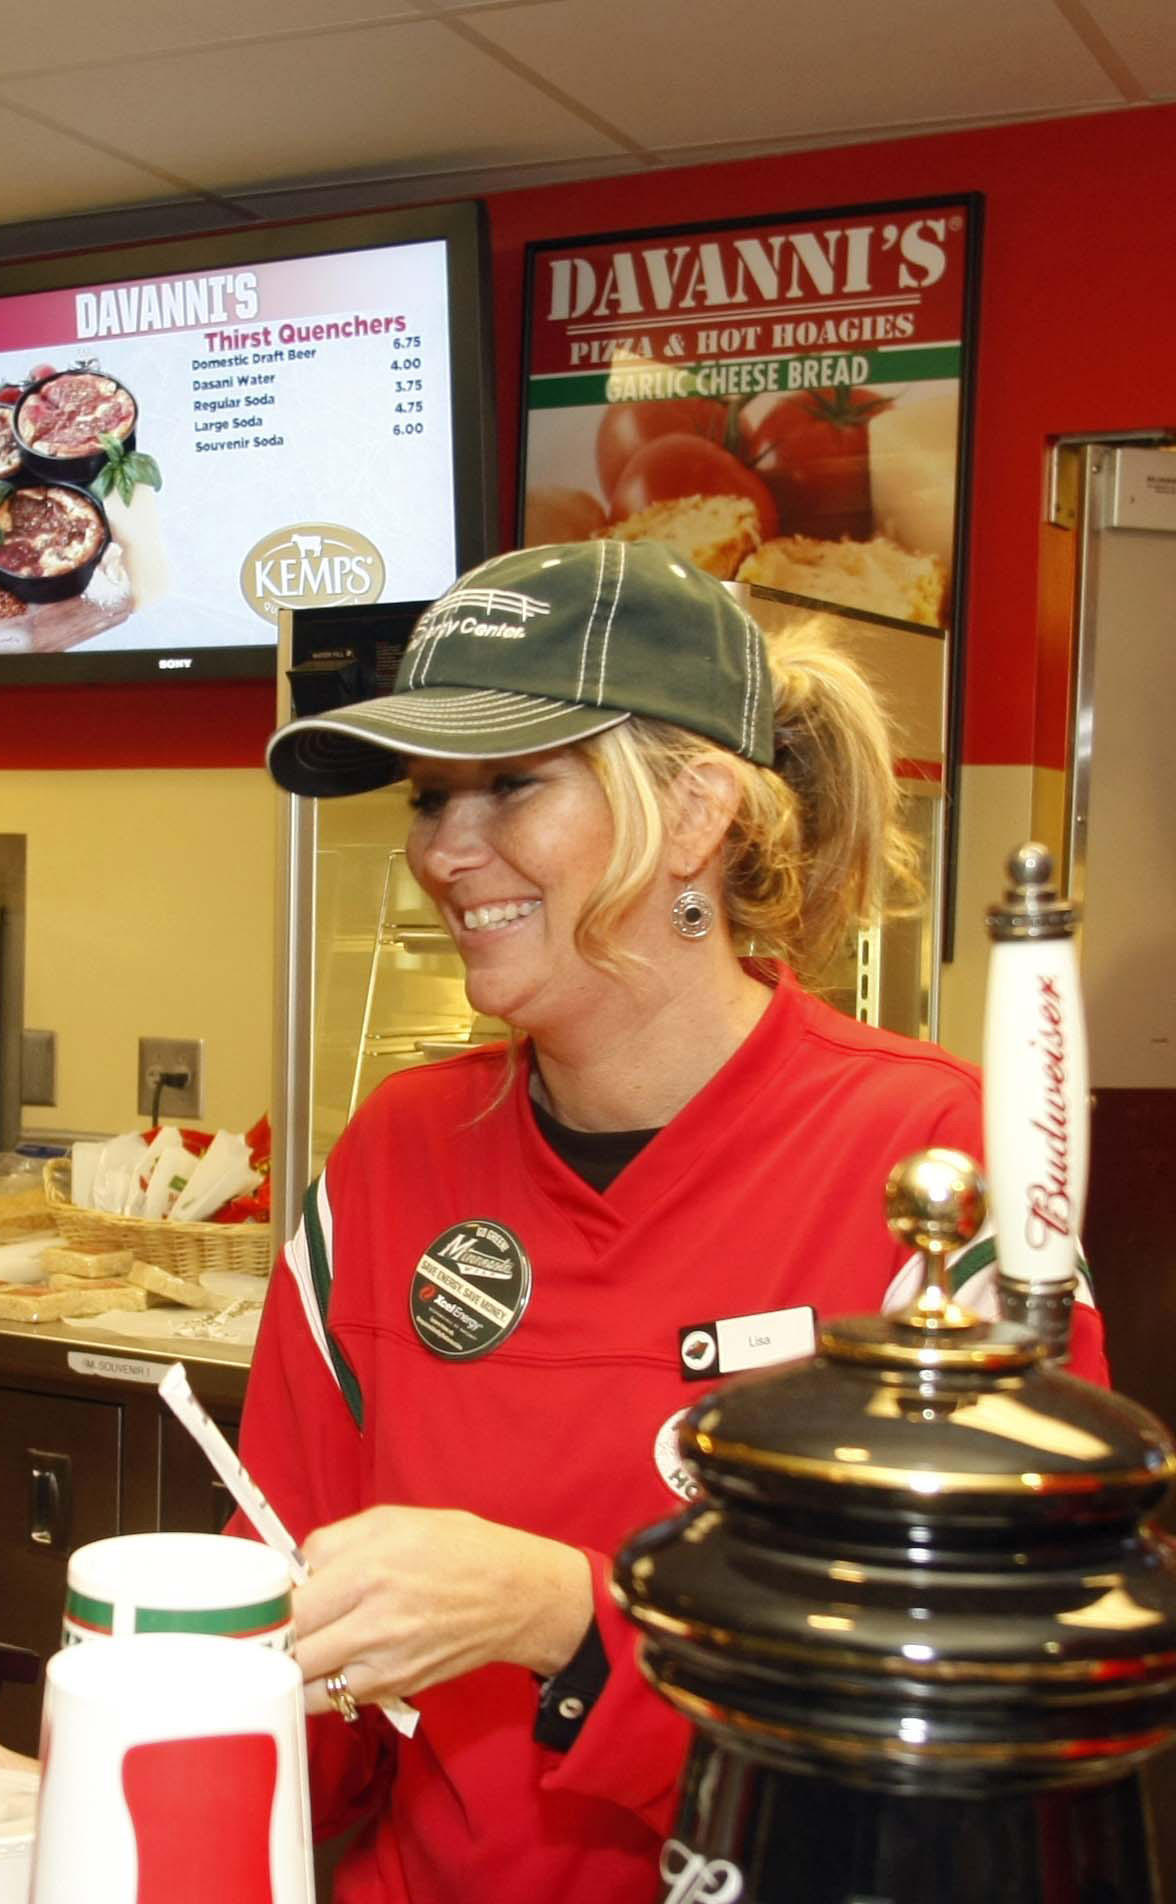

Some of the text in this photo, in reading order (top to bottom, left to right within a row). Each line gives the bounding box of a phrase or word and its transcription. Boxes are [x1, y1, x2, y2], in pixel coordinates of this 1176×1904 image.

[547, 218, 947, 321] DAVANNI'S
[75, 273, 258, 339] DAVANNI'S
[204, 314, 407, 352] Thirst Quenchers
[570, 313, 915, 365] PIZZA & HOT HOAGIES
[393, 336, 422, 350] 6.75
[192, 348, 317, 371] Domestic Draft Beer
[390, 358, 422, 371] 4.00
[192, 373, 276, 391] Dasani Water
[395, 379, 423, 393] 3.75
[606, 356, 869, 403] GARLIC CHEESE BREAD
[193, 394, 275, 413] Regular Soda
[394, 401, 423, 414] 4.75
[194, 415, 263, 434] Large Soda
[393, 423, 424, 436] 6.00
[195, 434, 284, 452] Souvenir Soda
[255, 555, 371, 598] KEMPS
[1025, 975, 1071, 1251] Budweiser
[748, 1335, 771, 1347] Lisa
